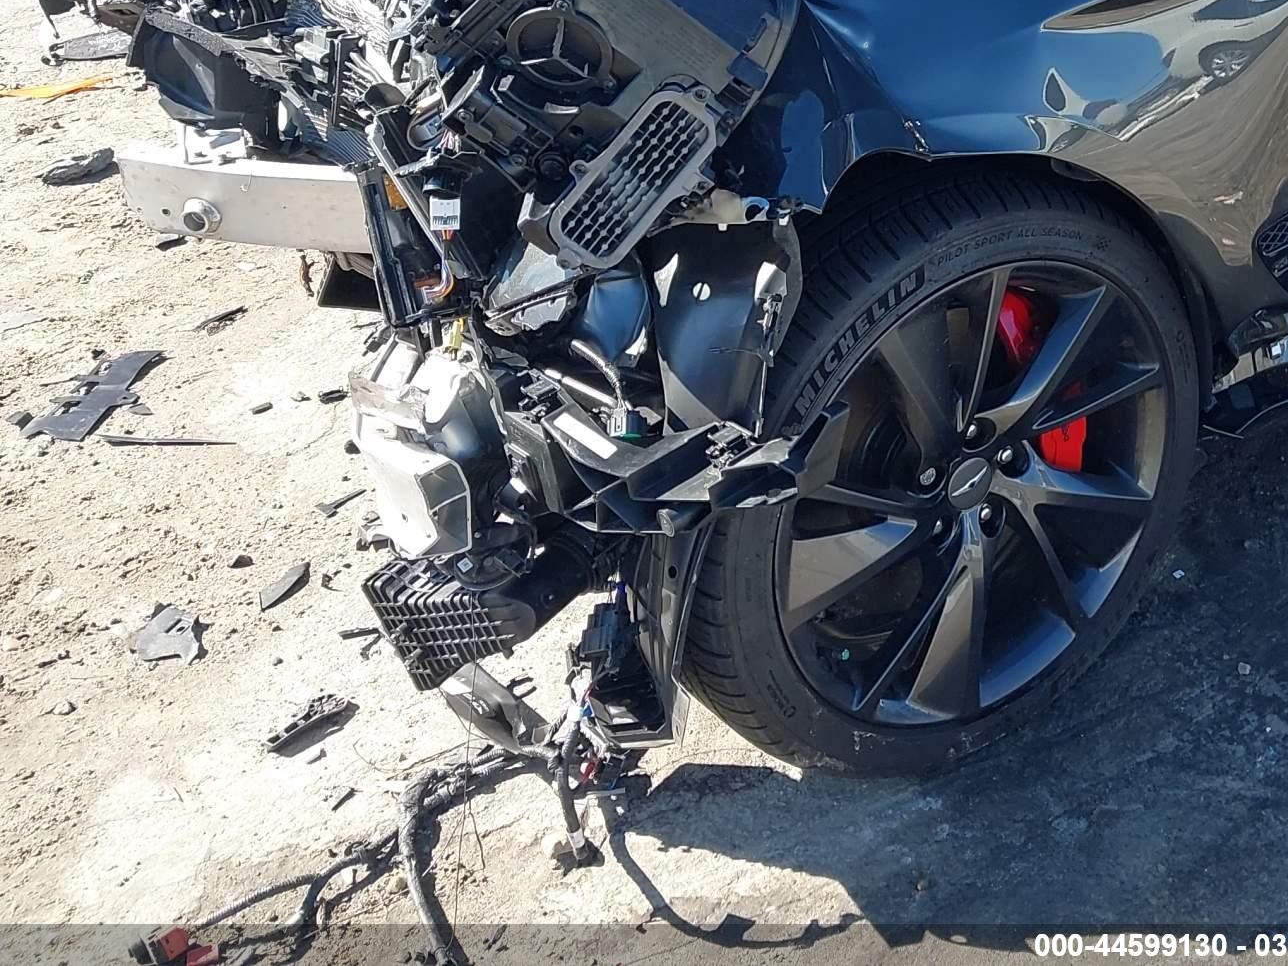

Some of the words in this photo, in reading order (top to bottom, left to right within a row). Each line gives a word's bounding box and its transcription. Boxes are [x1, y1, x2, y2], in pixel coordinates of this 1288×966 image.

[937, 243, 971, 267] PILOT
[973, 230, 1013, 251] SPORT
[1016, 229, 1036, 239] ALL
[1042, 227, 1083, 240] SEASON
[794, 271, 919, 418] MICHELIN
